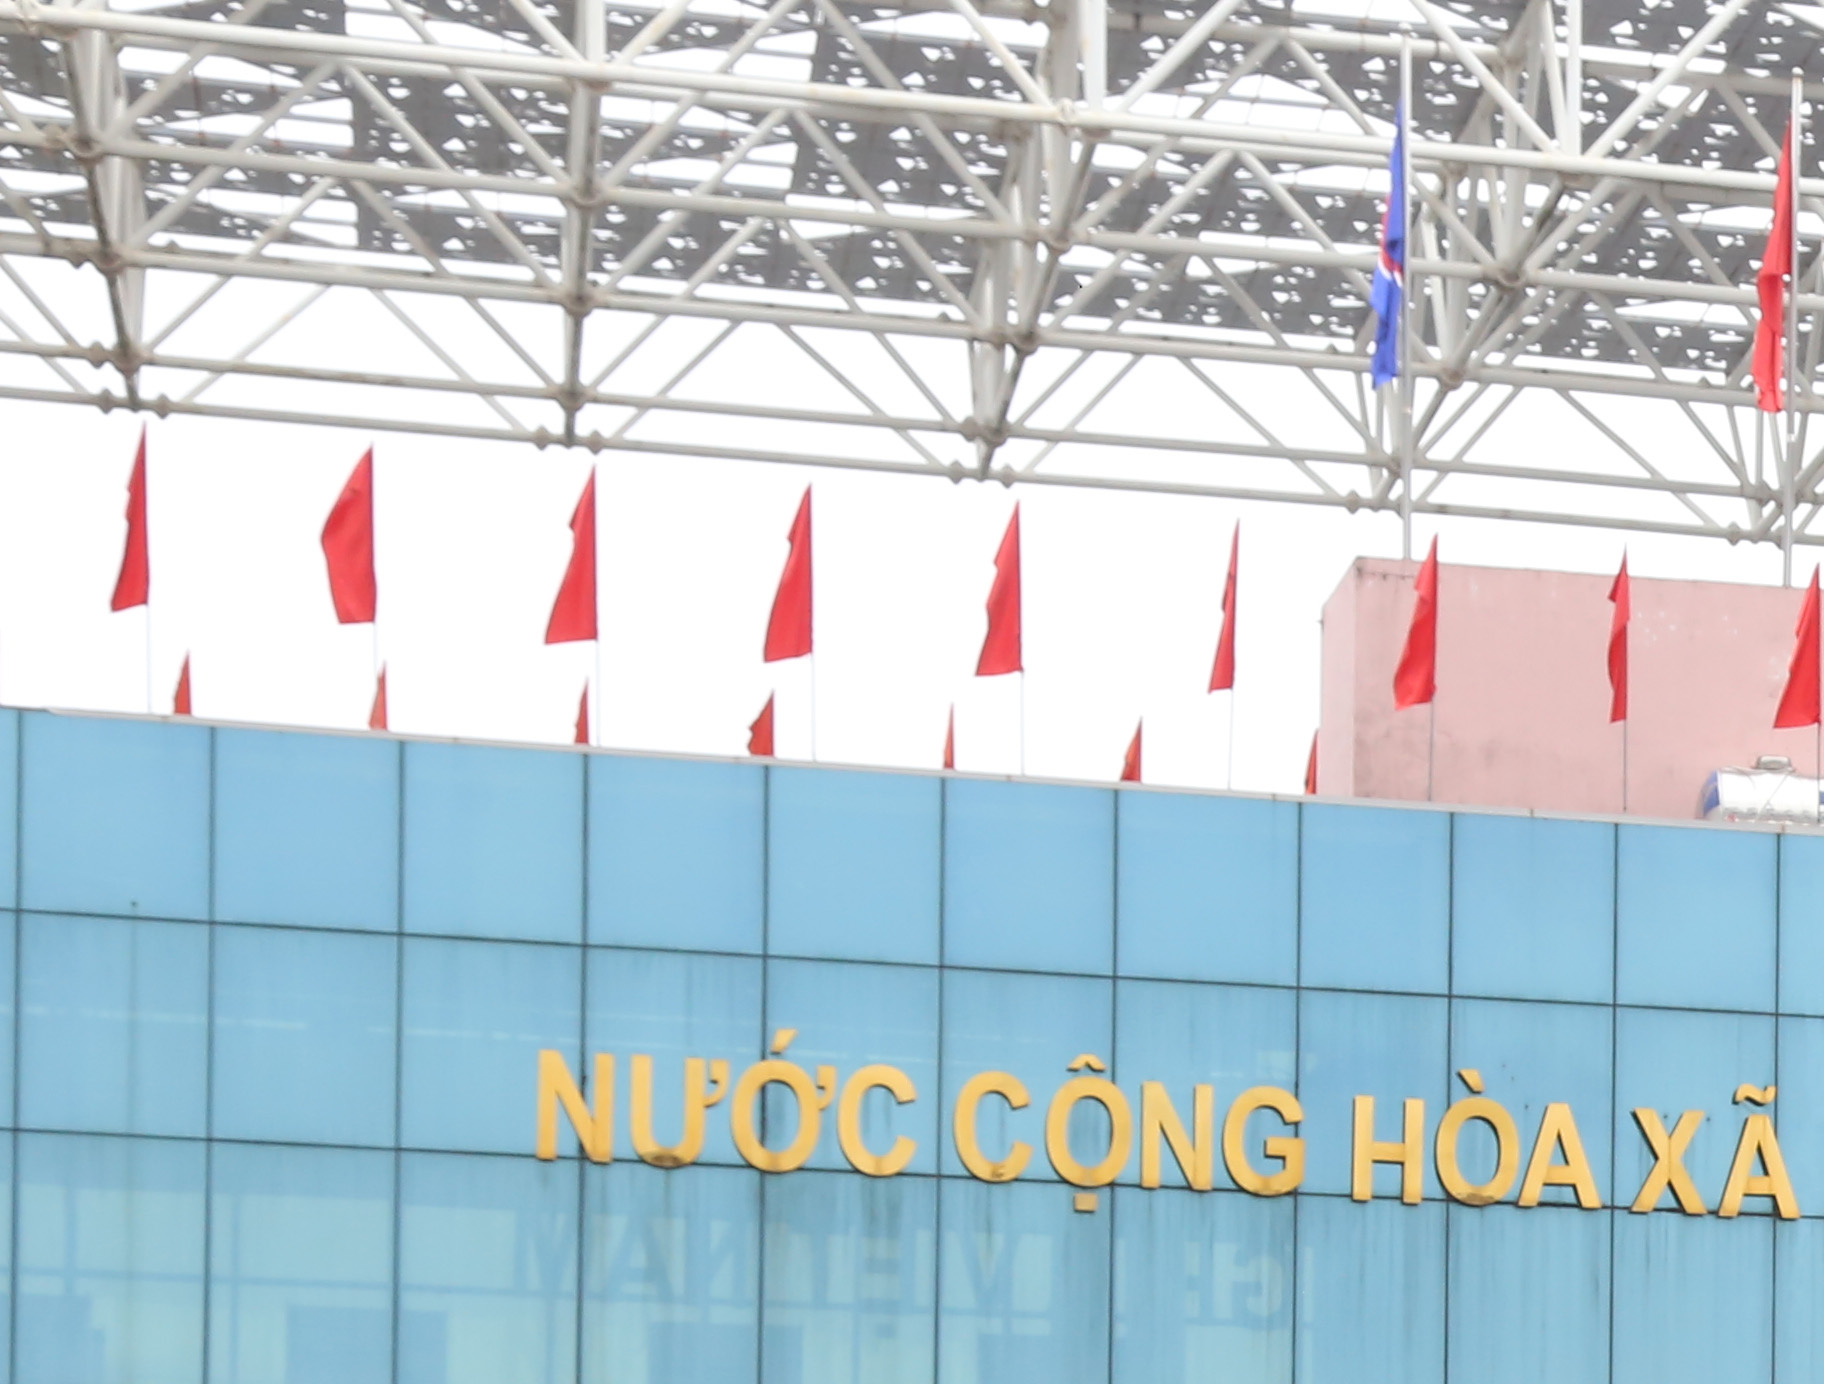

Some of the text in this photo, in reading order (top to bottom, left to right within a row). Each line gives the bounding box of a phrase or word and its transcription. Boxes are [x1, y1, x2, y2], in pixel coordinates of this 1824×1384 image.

[537, 1029, 915, 1177] NƯỚC
[955, 1054, 1305, 1212] CỘNG
[1353, 1070, 1601, 1209] HÒA
[1635, 1084, 1800, 1219] XÃ
